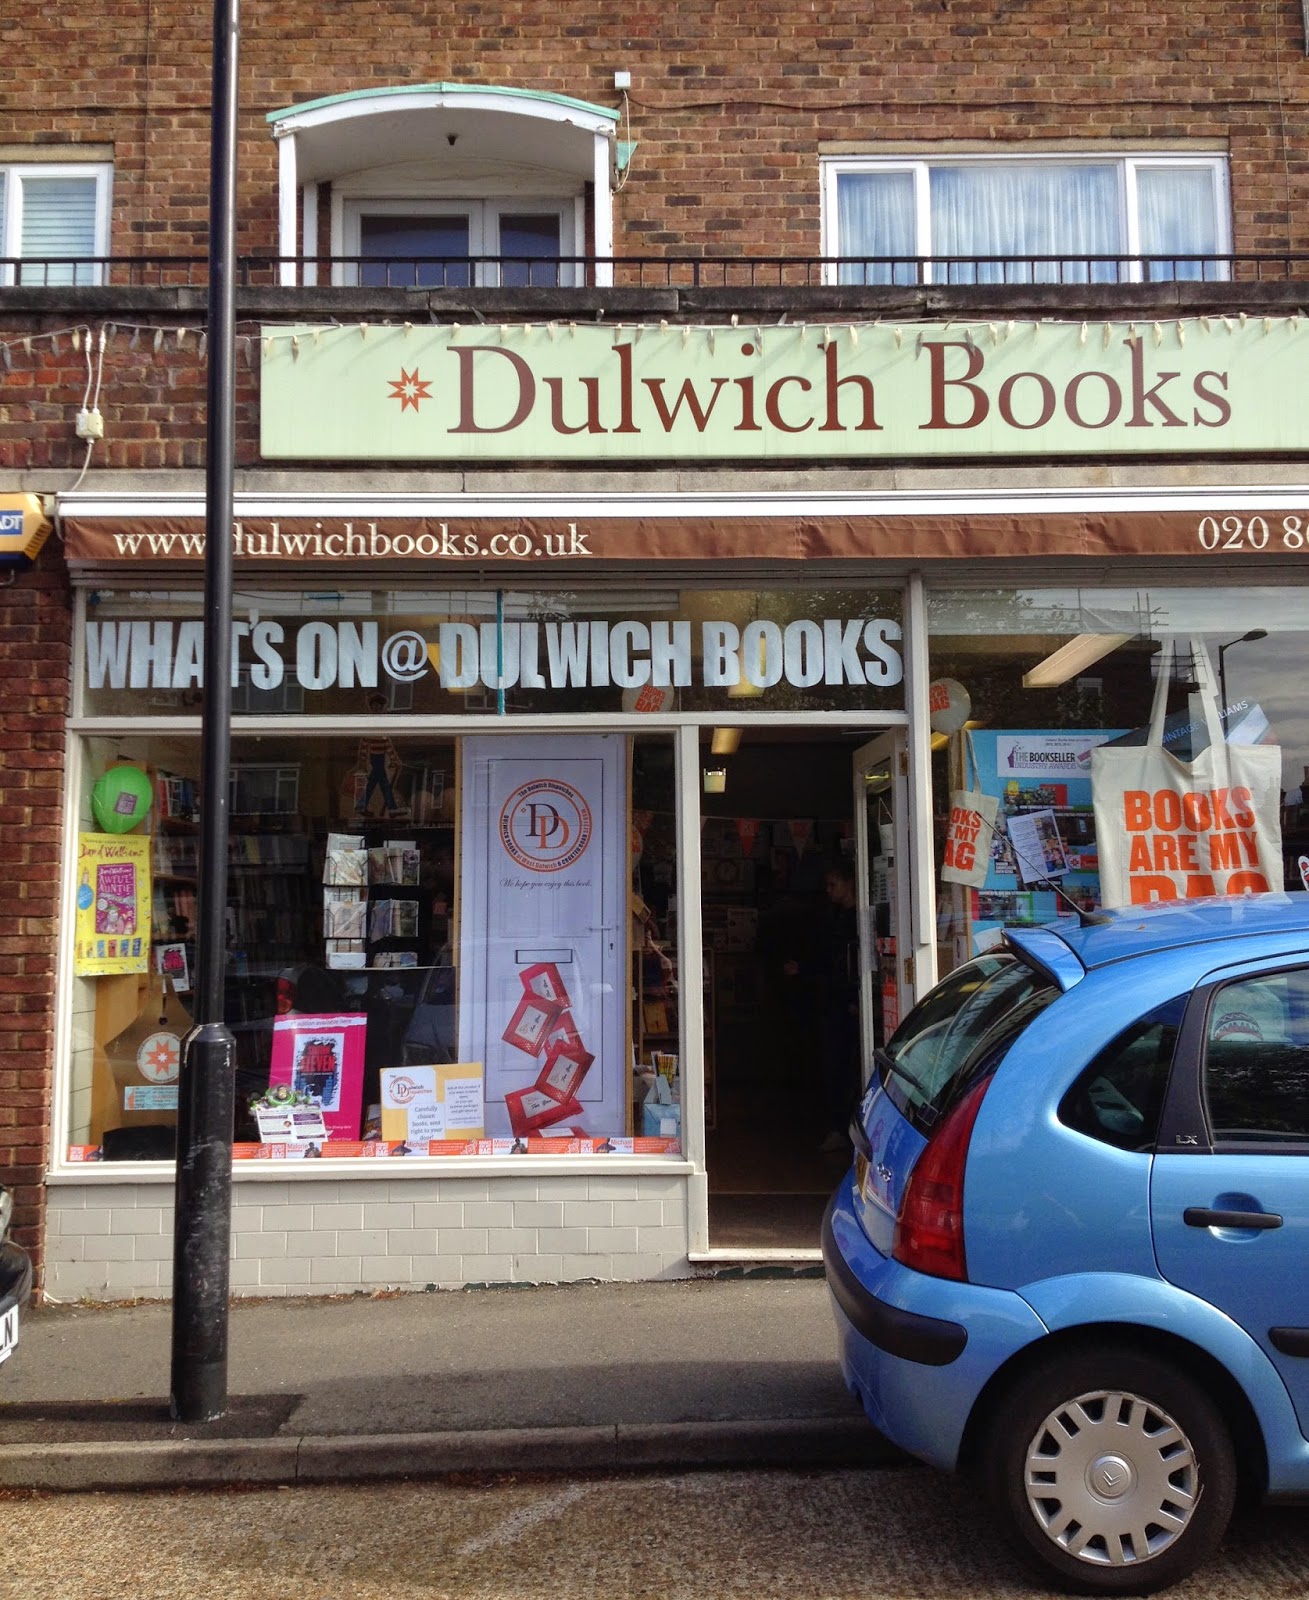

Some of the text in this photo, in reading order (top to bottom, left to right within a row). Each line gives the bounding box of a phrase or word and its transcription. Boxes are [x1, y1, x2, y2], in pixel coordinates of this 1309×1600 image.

[447, 337, 1232, 434] Dulwich Books
[113, 522, 592, 556] wwwdulwichbooks.co.uk
[1198, 515, 1309, 549] 020 8
[297, 621, 378, 690] ON
[381, 630, 429, 682] @
[440, 620, 692, 689] DULWICH
[702, 619, 904, 688] BOOKS
[1015, 752, 1028, 762] THE
[1029, 752, 1076, 763] BOOKSELLER
[951, 807, 981, 829] OKS
[1124, 786, 1256, 832] BOOKS
[1129, 832, 1260, 872] ARE MY
[515, 880, 530, 890] hope
[531, 882, 543, 890] you
[1175, 1134, 1198, 1145] LX
